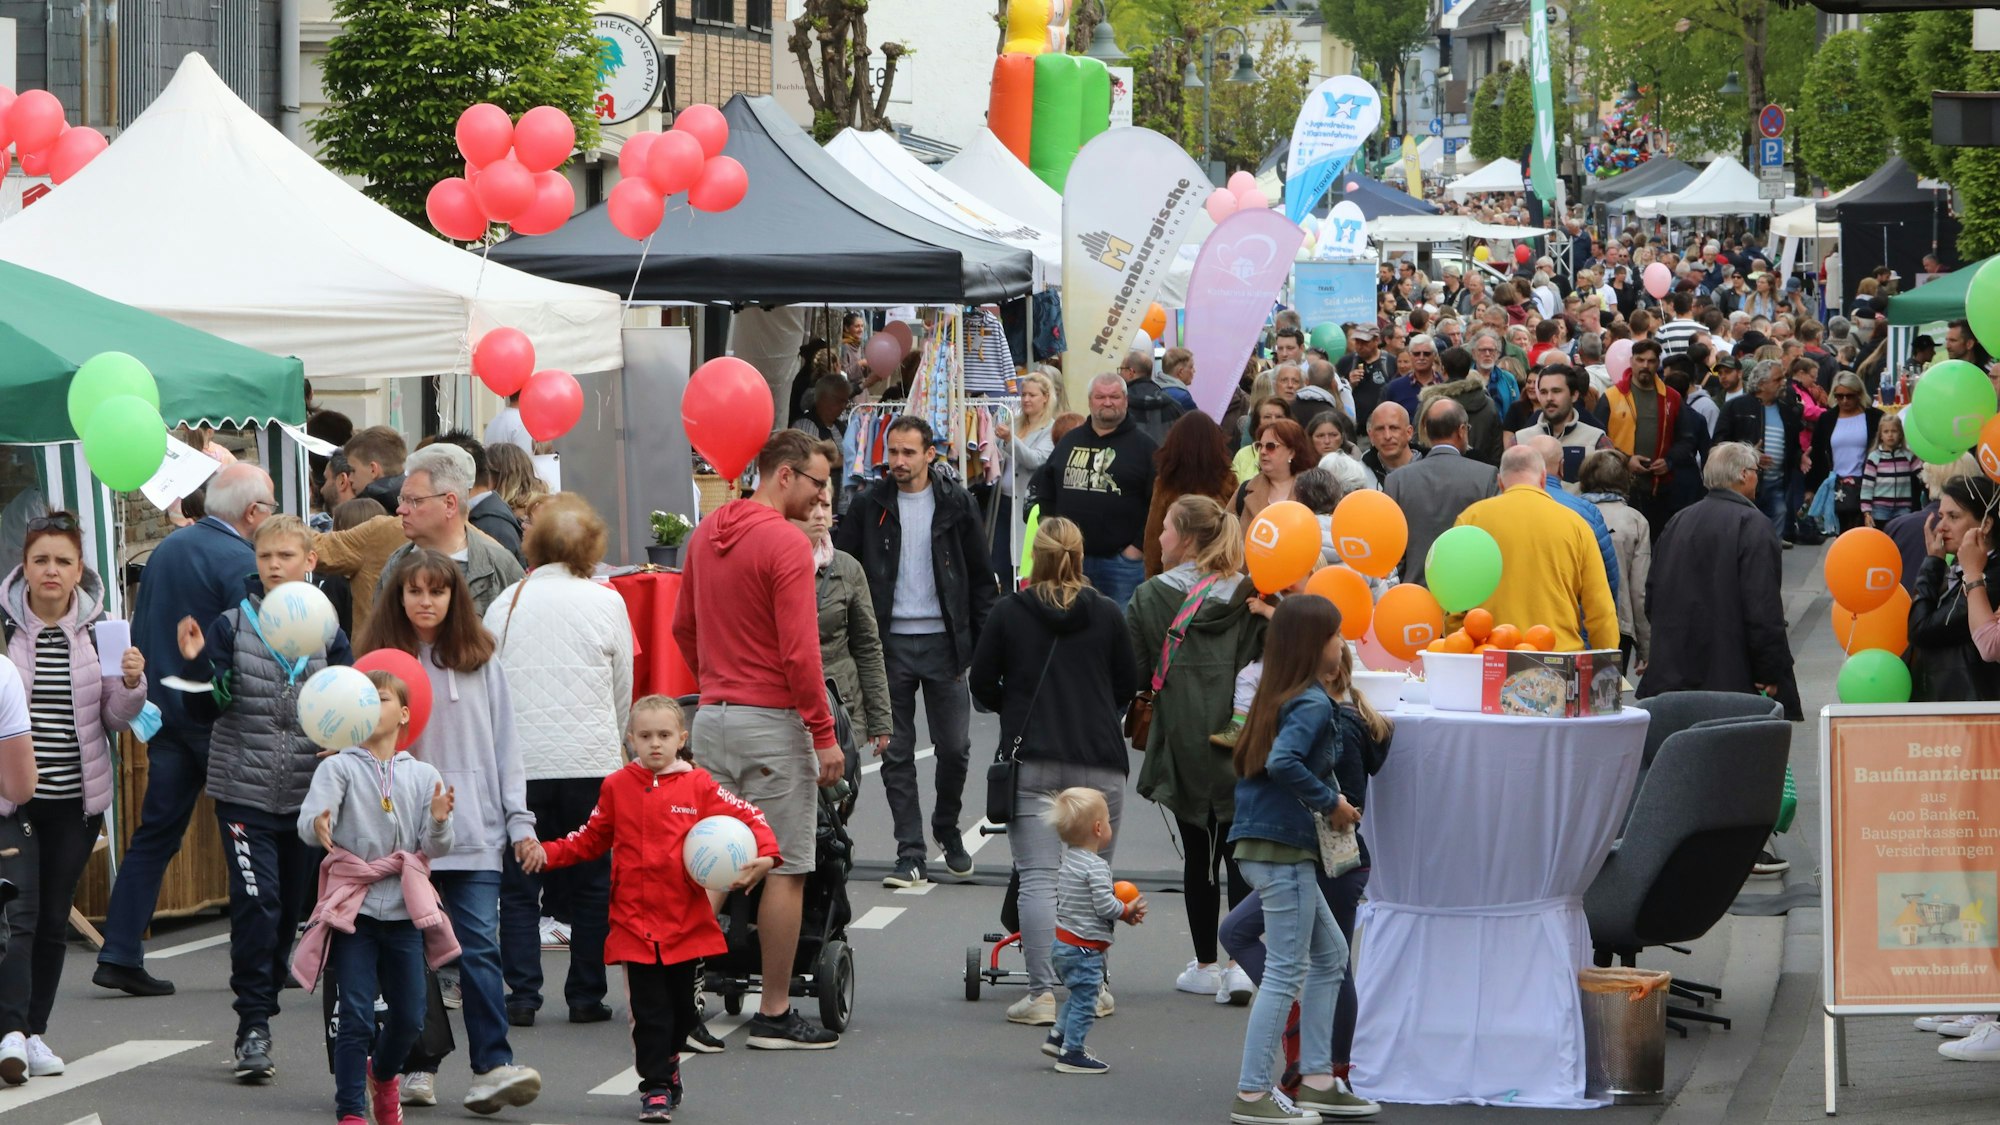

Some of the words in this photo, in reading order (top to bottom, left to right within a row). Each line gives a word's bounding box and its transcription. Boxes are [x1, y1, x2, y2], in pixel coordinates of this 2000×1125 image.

[634, 35, 655, 93] OVERATH
[1765, 141, 1779, 163] P
[1091, 178, 1191, 355] Mecklenburgische
[1908, 742, 1962, 758] Beste
[1920, 792, 1947, 802] aus
[1888, 810, 1915, 822] 400
[1920, 807, 1980, 821] Banken,
[1861, 826, 1974, 842] Bausparkassen
[1875, 844, 1994, 859] Versicherungen
[233, 839, 259, 897] Zeus
[1890, 963, 1988, 976] www.baufi.tv
